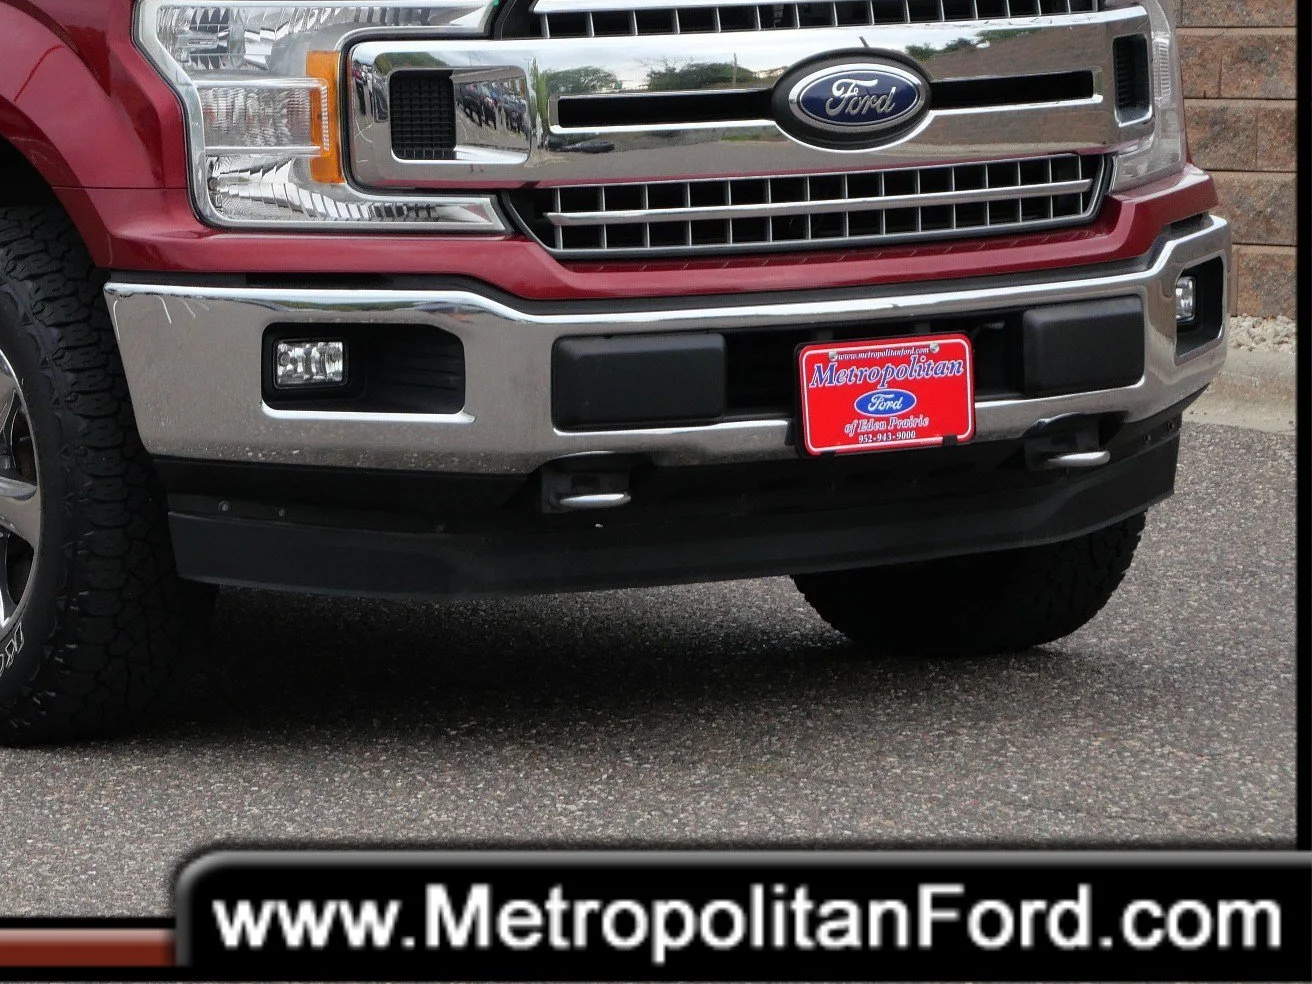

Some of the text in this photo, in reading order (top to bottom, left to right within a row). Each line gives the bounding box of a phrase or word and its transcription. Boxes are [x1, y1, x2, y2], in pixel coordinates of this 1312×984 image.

[825, 78, 897, 116] Ford
[837, 347, 930, 361] www.metropolitanford.com
[809, 355, 964, 389] Metropolitan
[867, 393, 903, 412] Ford
[844, 414, 929, 436] of Eden Prairie
[858, 431, 917, 444] 952-943-9000
